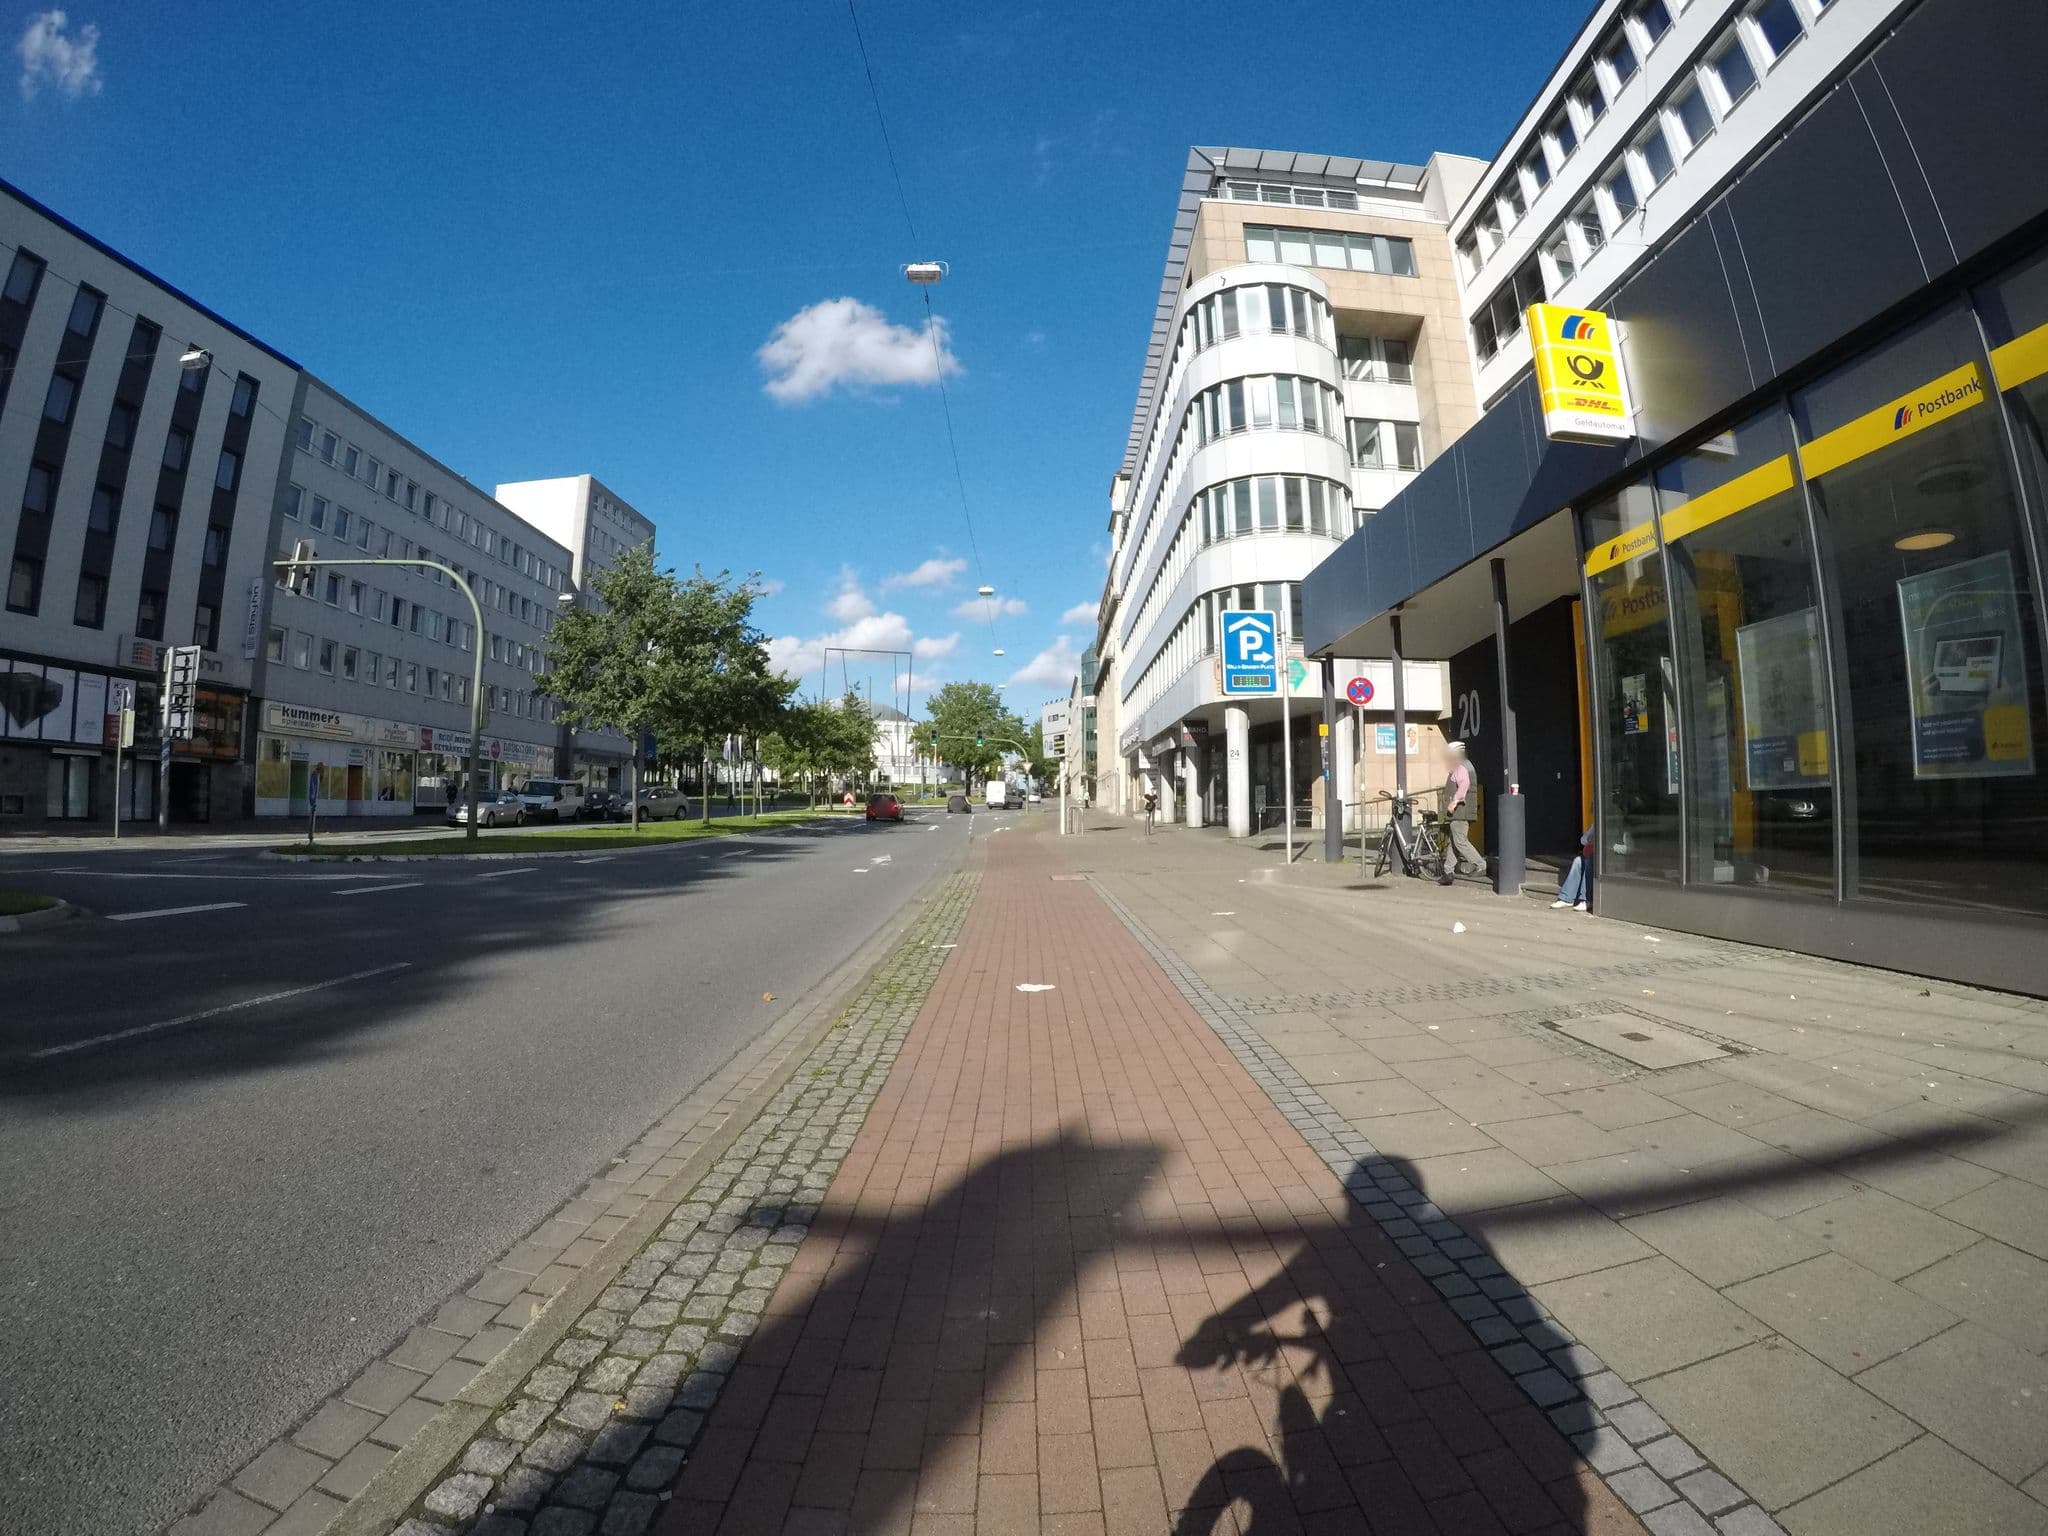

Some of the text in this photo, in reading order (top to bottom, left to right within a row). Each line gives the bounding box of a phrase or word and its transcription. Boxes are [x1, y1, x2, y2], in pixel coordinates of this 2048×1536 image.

[1574, 398, 1611, 410] DHL
[1918, 377, 1982, 417] Postbank
[1574, 418, 1625, 430] Geldautomat
[1622, 528, 1657, 554] Postbank
[1239, 630, 1263, 661] P
[1458, 689, 1481, 739] 20
